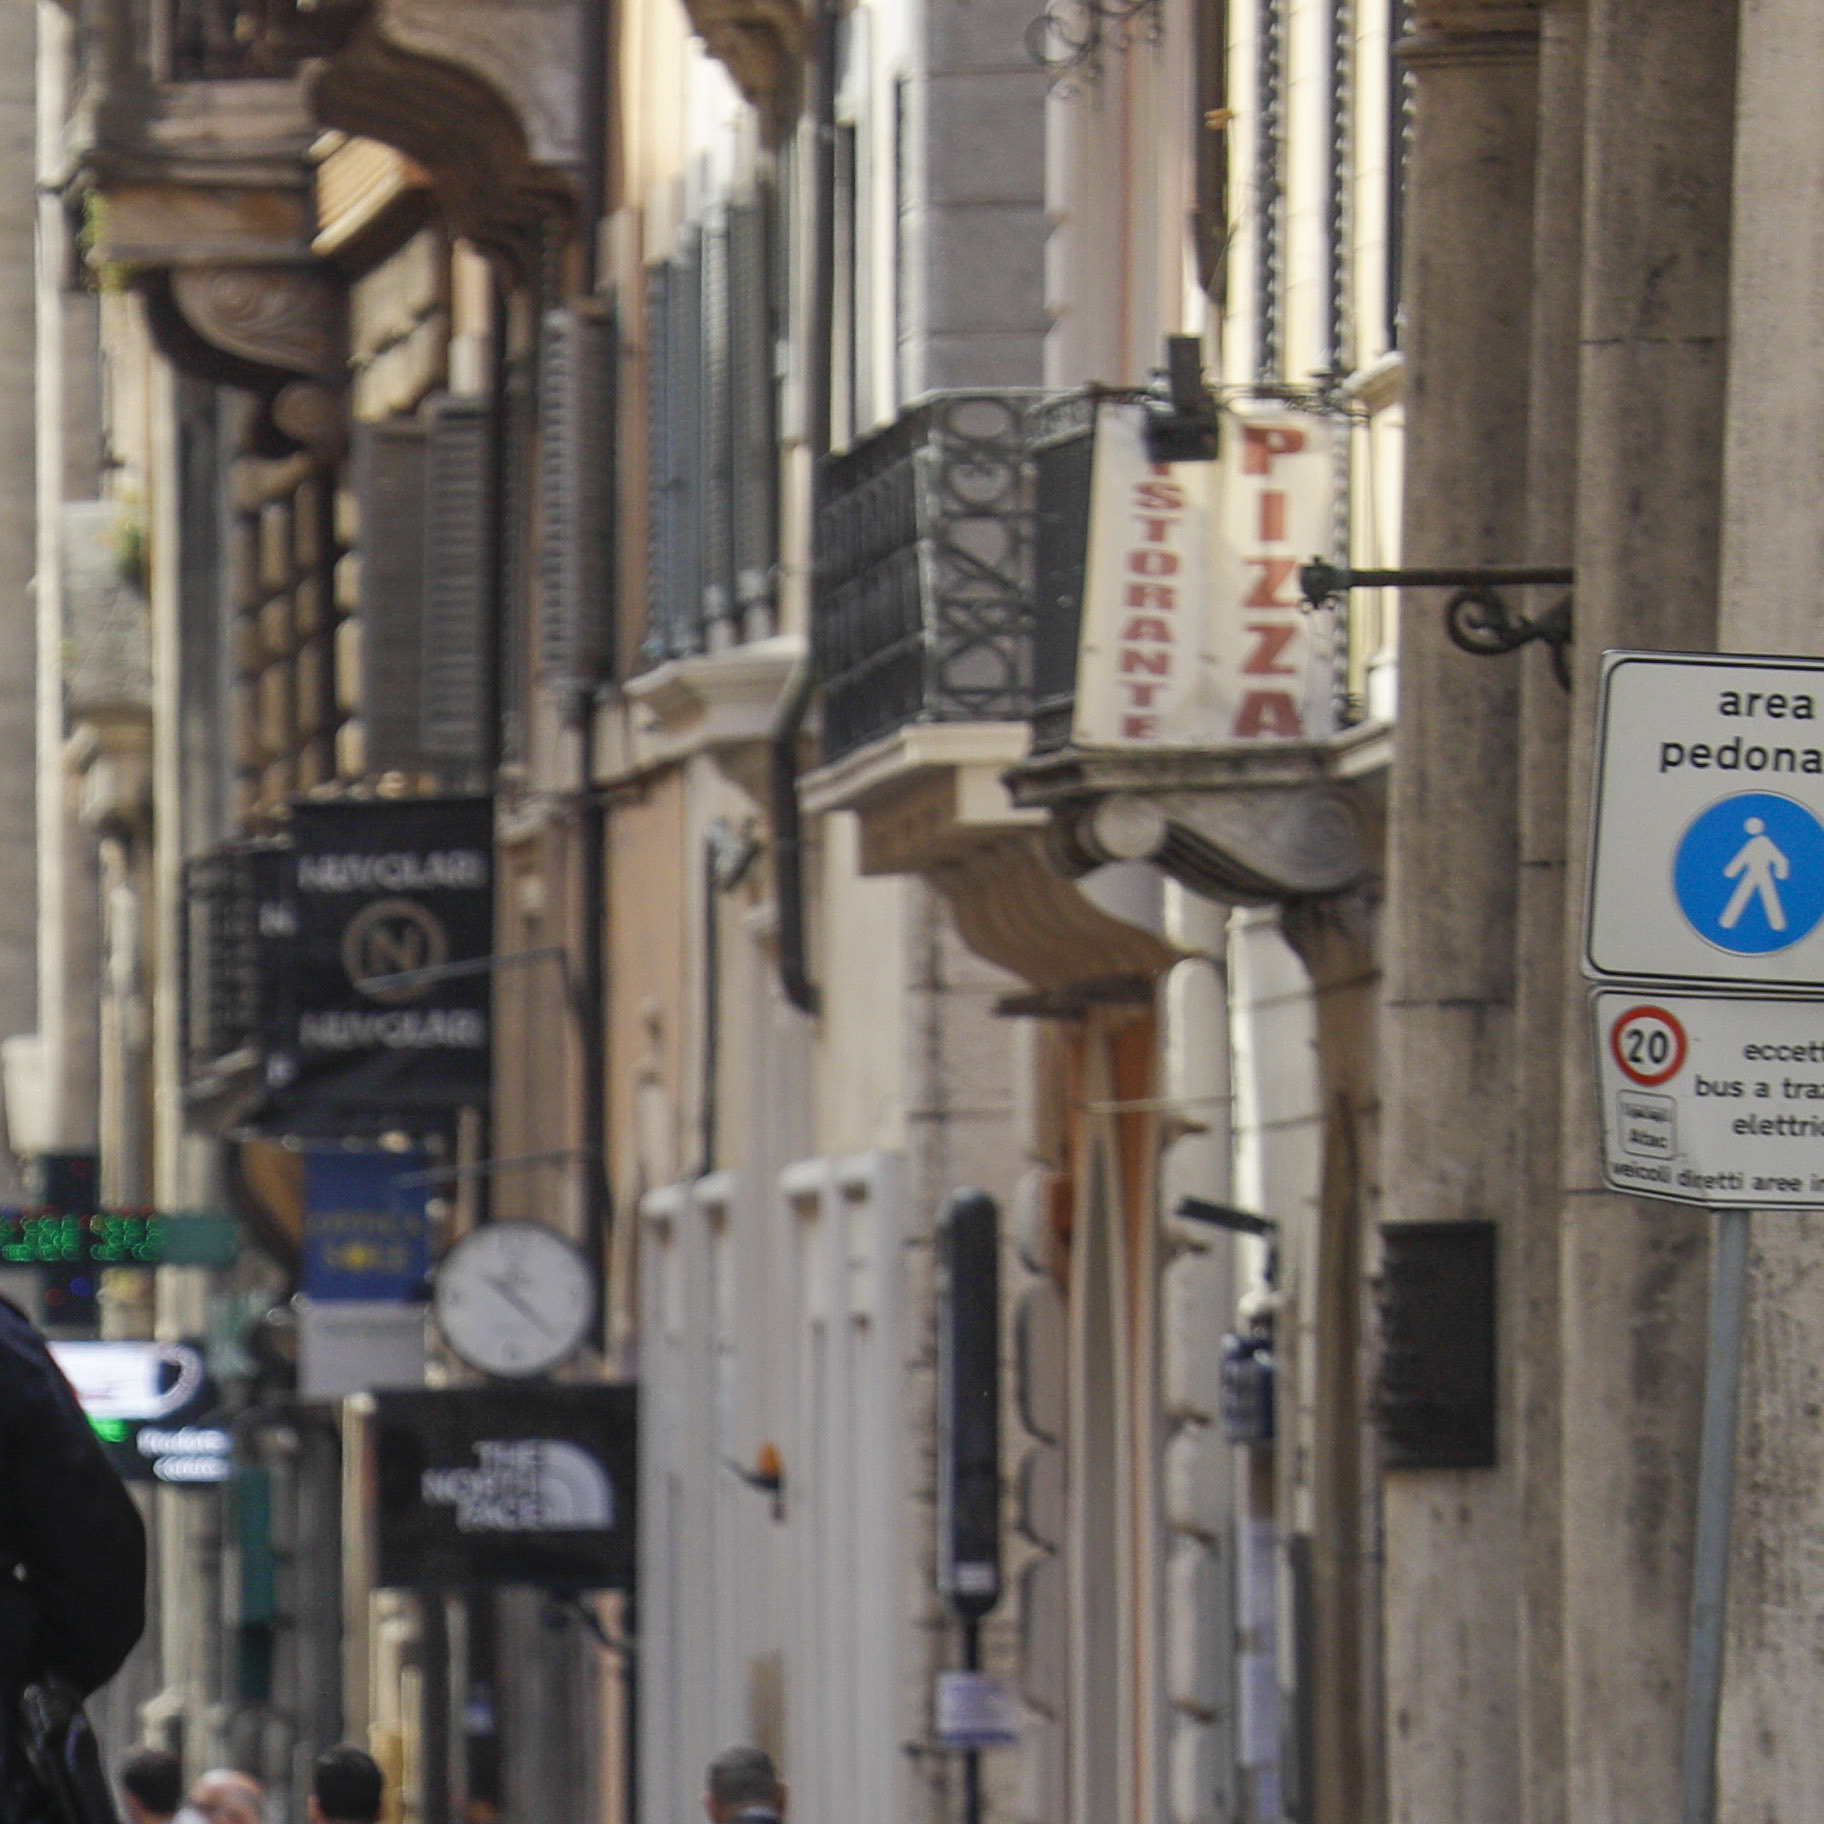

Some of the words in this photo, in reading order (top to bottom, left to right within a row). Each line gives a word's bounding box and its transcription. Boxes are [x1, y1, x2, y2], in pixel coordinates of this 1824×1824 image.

[1232, 425, 1308, 740] PIZZA
[1118, 460, 1186, 740] STORANTE
[1719, 689, 1816, 720] area
[1627, 1028, 1669, 1064] 20
[1695, 1074, 1744, 1098] bus
[1755, 1081, 1770, 1098] a
[1753, 1176, 1803, 1192] aree
